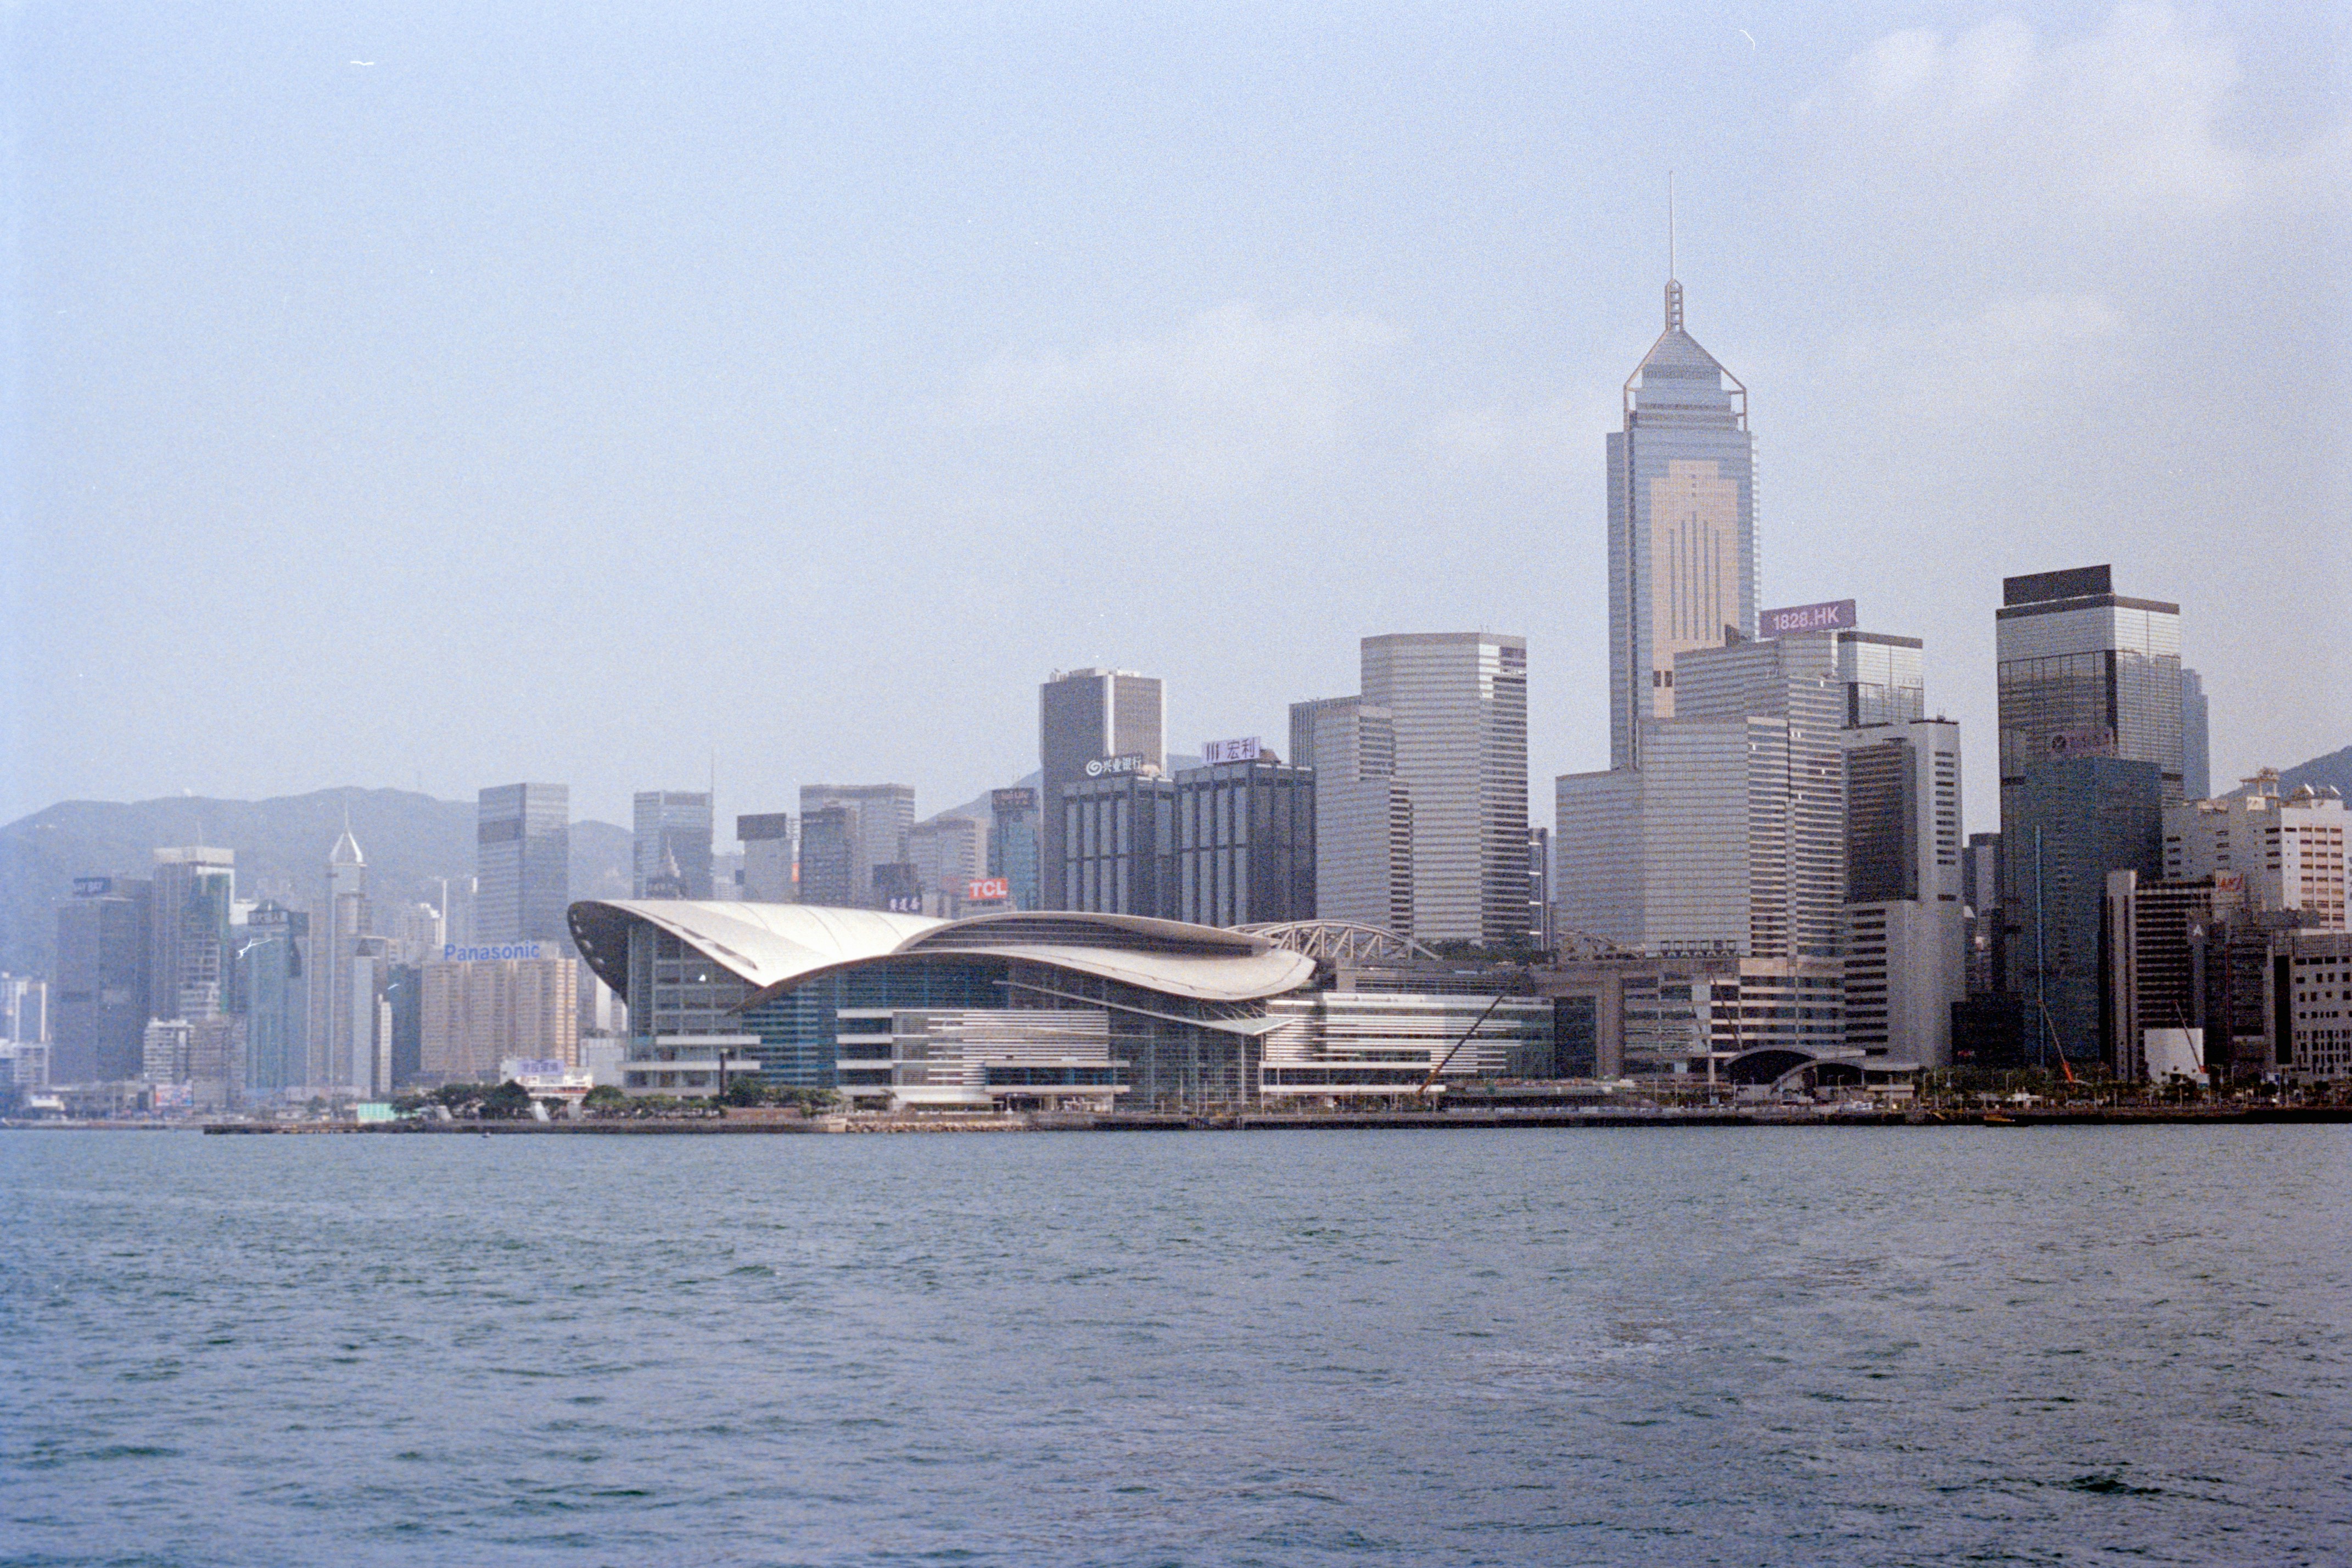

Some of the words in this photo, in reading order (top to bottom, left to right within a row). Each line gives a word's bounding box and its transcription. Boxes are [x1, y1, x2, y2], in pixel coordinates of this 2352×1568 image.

[1773, 606, 1840, 630] 1828.HK
[1227, 737, 1255, 759] 宏利
[1103, 756, 1142, 772] 兴业银行
[969, 881, 1007, 897] TCL
[444, 940, 540, 961] Panasonic
